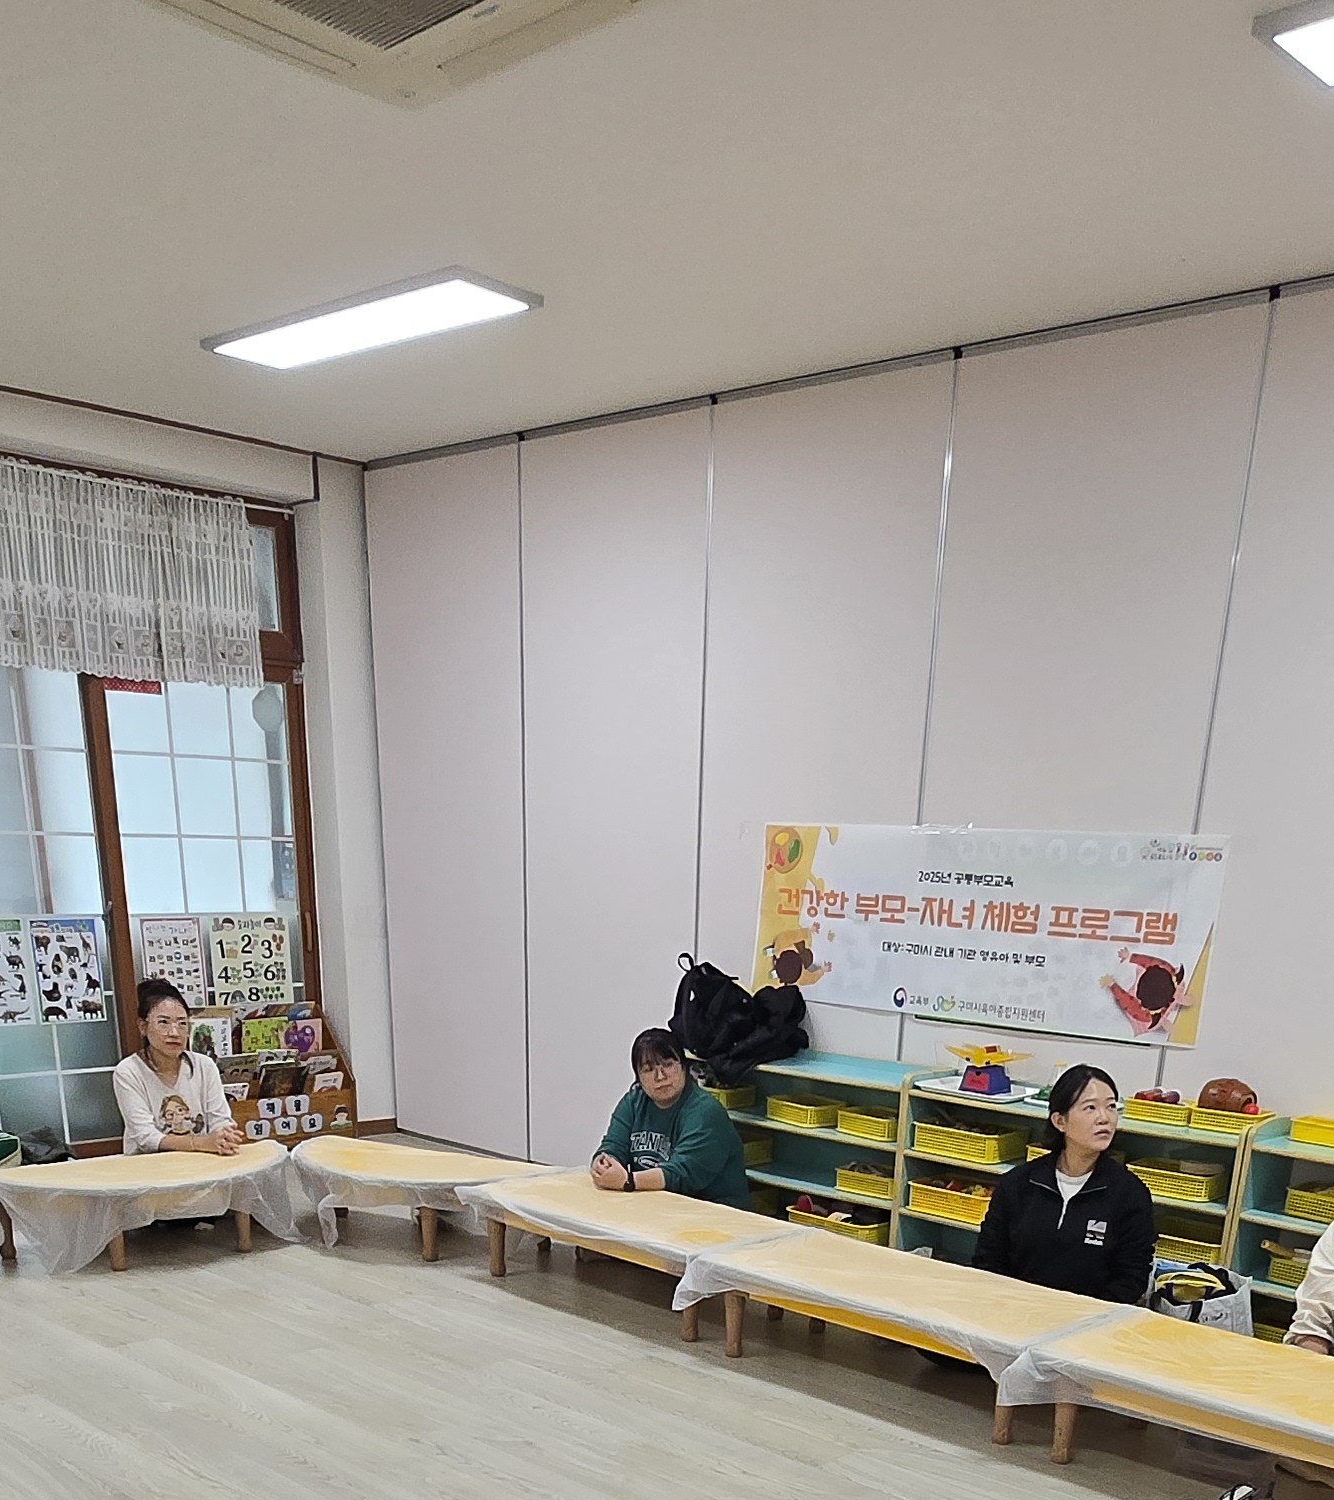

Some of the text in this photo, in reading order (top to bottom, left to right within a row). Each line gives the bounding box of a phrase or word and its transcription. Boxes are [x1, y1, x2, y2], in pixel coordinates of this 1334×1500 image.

[918, 871, 952, 885] 2025년
[777, 888, 1178, 945] 건강한 부모-자녀 체험 프로그램
[216, 934, 273, 959] 1 2 3
[934, 946, 954, 959] 관내
[958, 948, 977, 960] 기관
[980, 950, 1010, 963] 영유아
[1012, 953, 1023, 964] 및
[1025, 955, 1046, 968] 부모
[217, 961, 276, 983] 4 5 6
[218, 987, 260, 1006] 7 8
[909, 995, 930, 1005] 교육부
[958, 1001, 1046, 1022] 구미시육아종합지원센터
[253, 1118, 317, 1136] 읽어요
